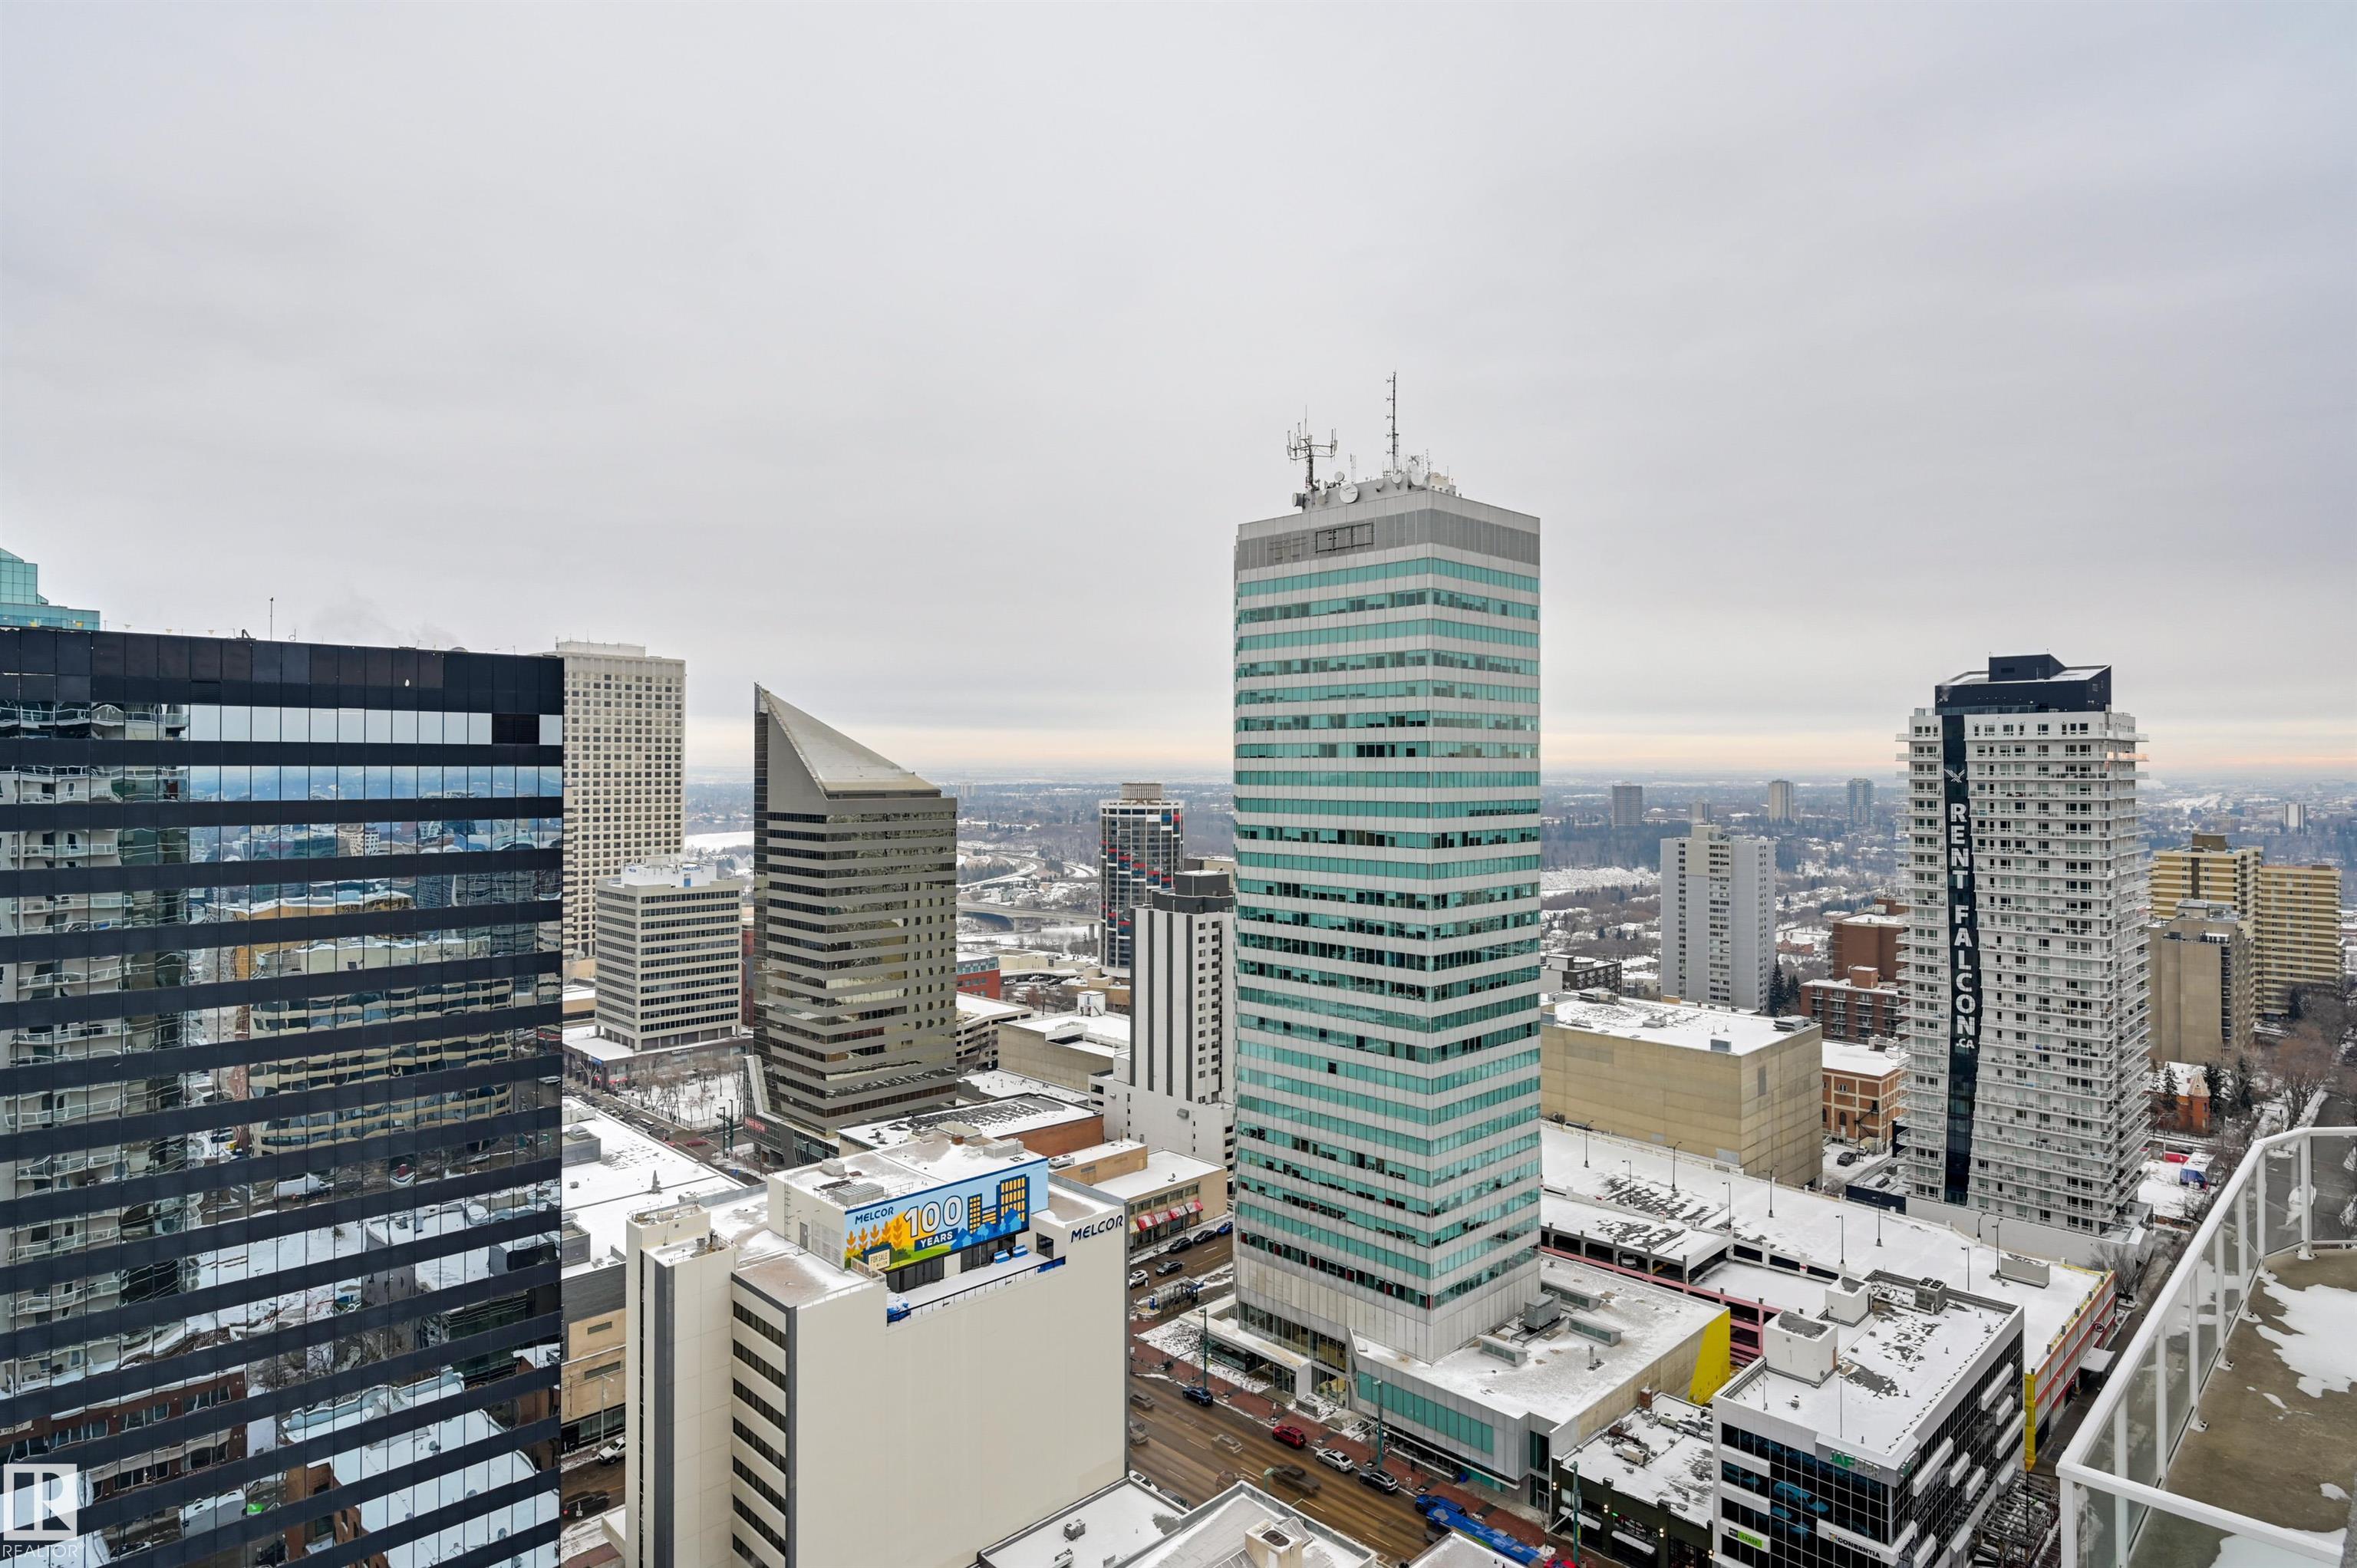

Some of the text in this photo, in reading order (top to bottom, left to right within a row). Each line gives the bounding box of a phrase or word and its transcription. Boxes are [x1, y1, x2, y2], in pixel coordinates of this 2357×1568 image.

[1950, 803, 1970, 889] RENT
[855, 1207, 894, 1225] MELCOR
[903, 1195, 963, 1238] 100
[1071, 1214, 1124, 1243] MELCOR
[920, 1231, 953, 1248] YEARS
